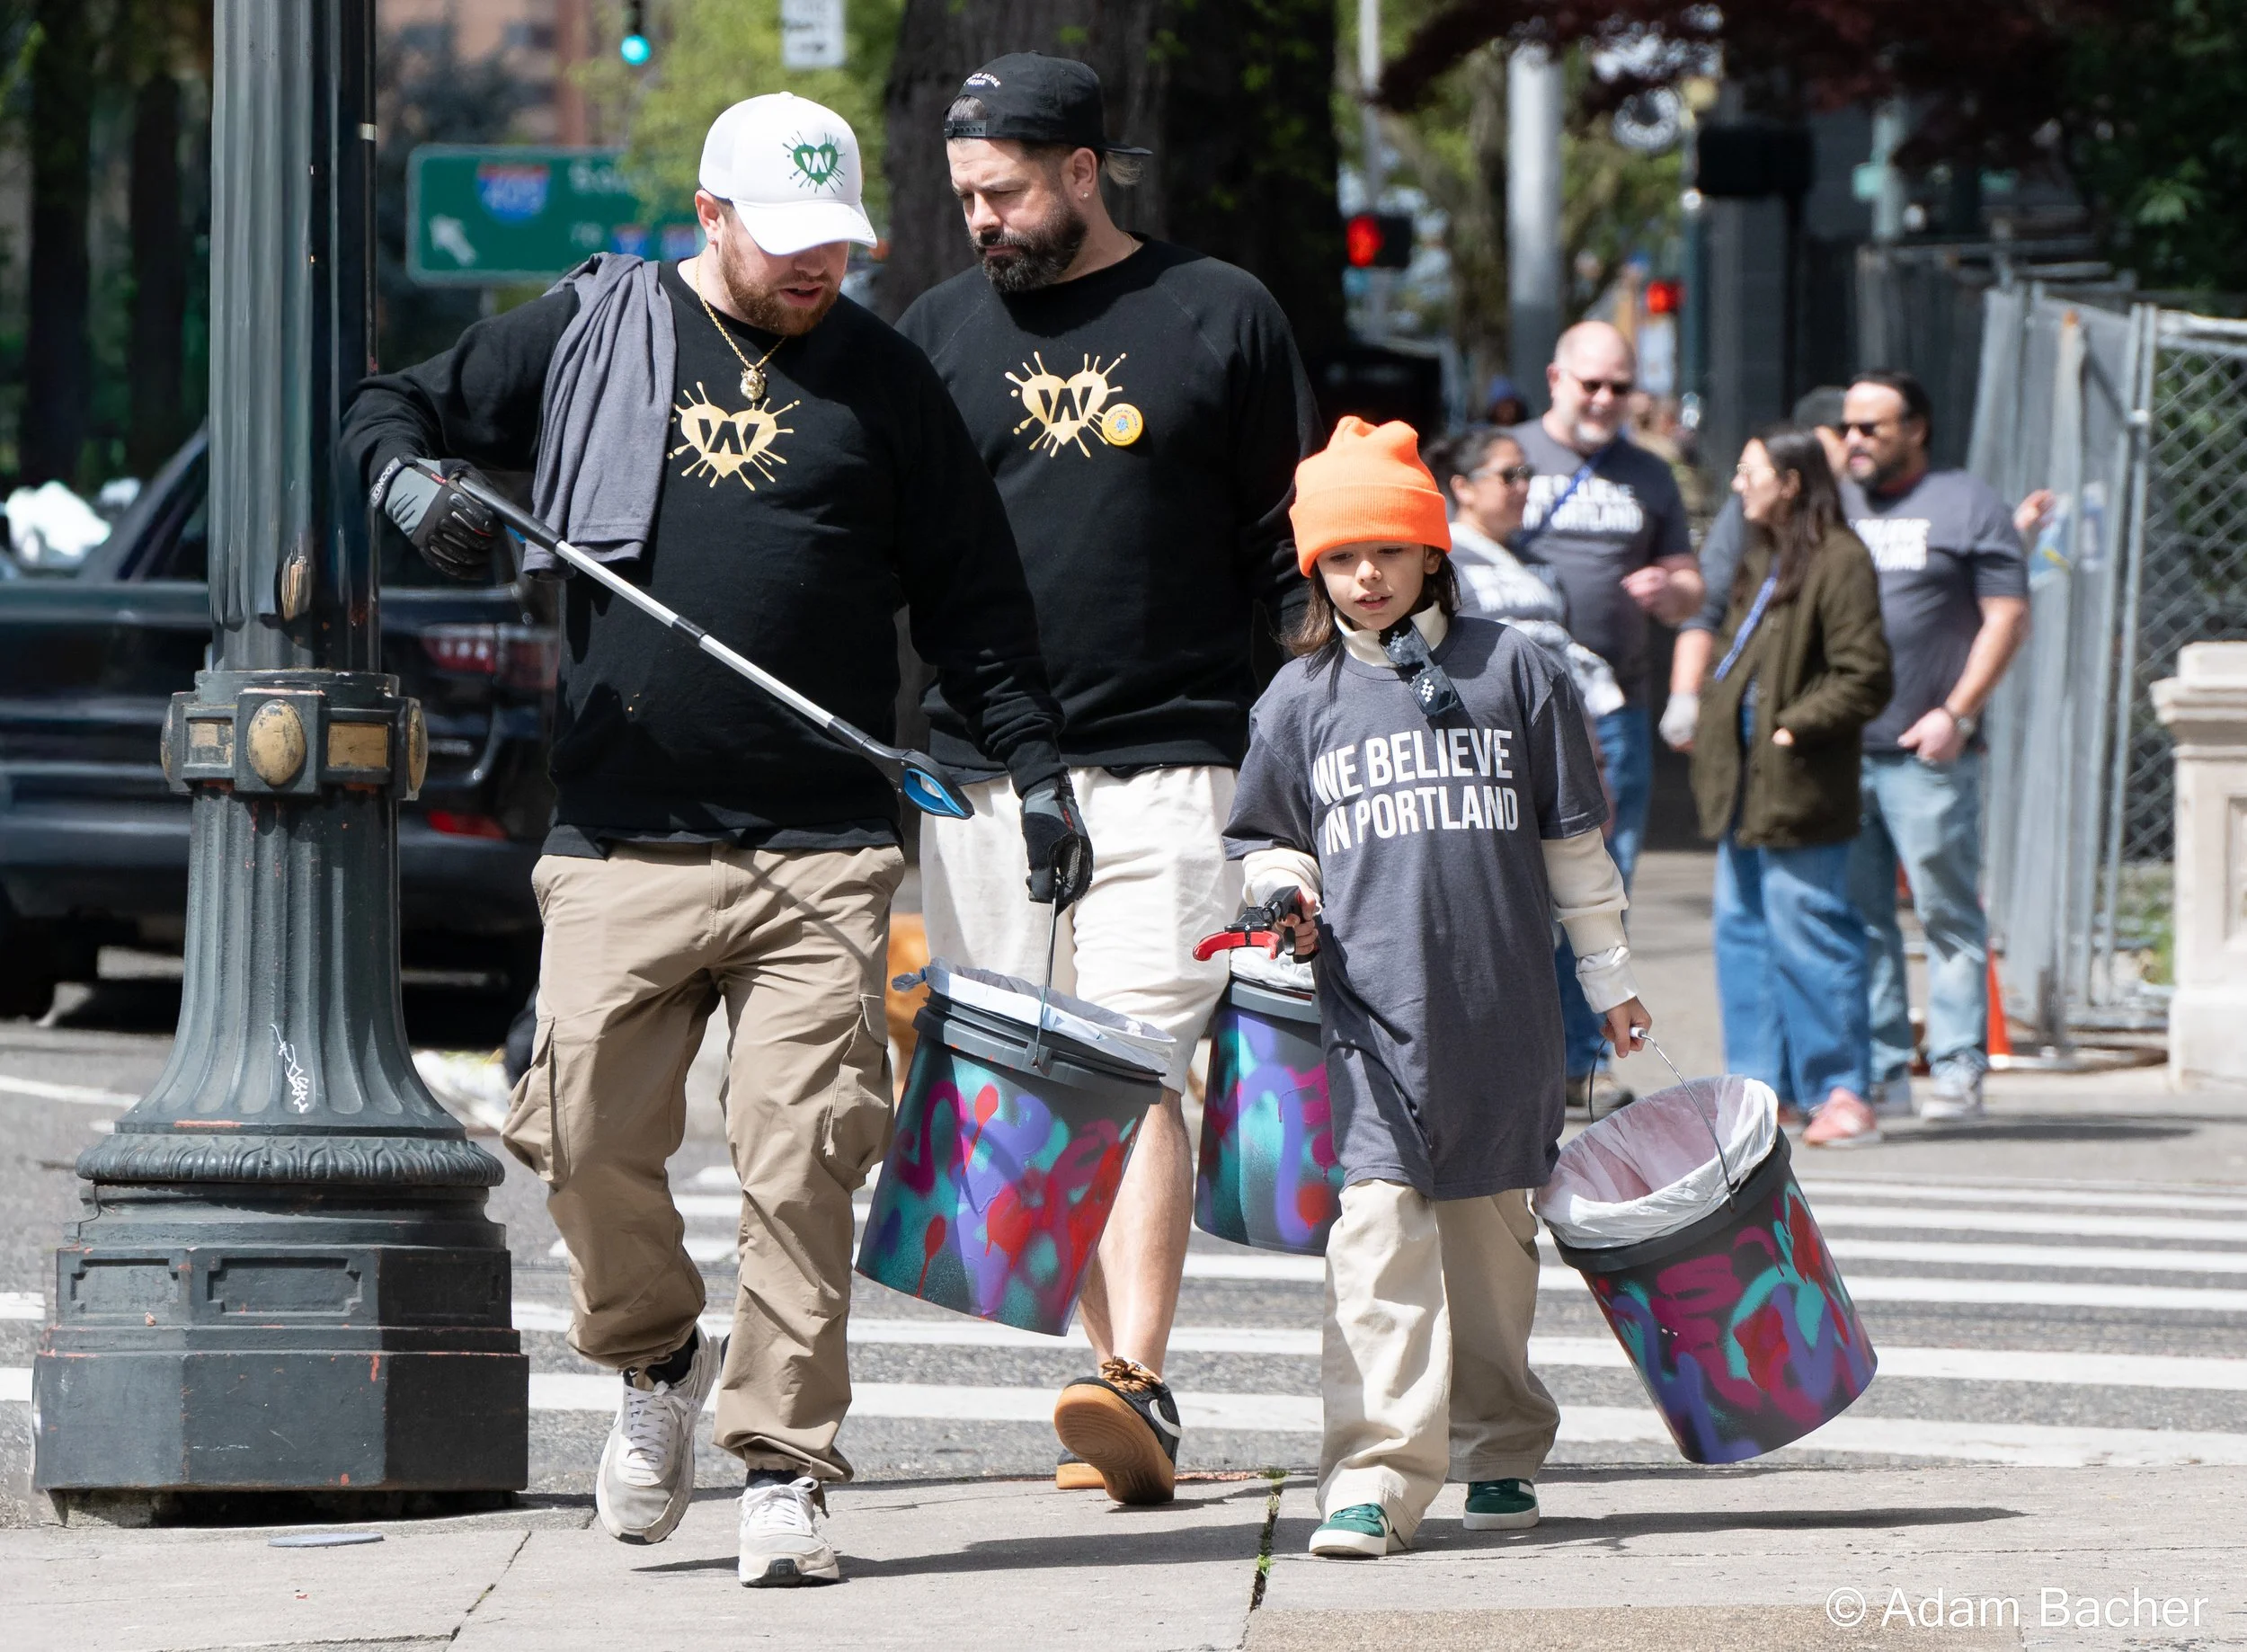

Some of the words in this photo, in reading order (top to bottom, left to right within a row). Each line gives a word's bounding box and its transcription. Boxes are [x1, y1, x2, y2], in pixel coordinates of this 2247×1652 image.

[801, 151, 831, 173] W
[1037, 386, 1093, 423] W
[697, 418, 760, 456] W
[371, 466, 394, 500] KINCO
[1312, 744, 1364, 806] WE
[1365, 728, 1513, 787] BELIEVE
[1325, 805, 1352, 856] IN
[1354, 785, 1519, 844] PORTLAND
